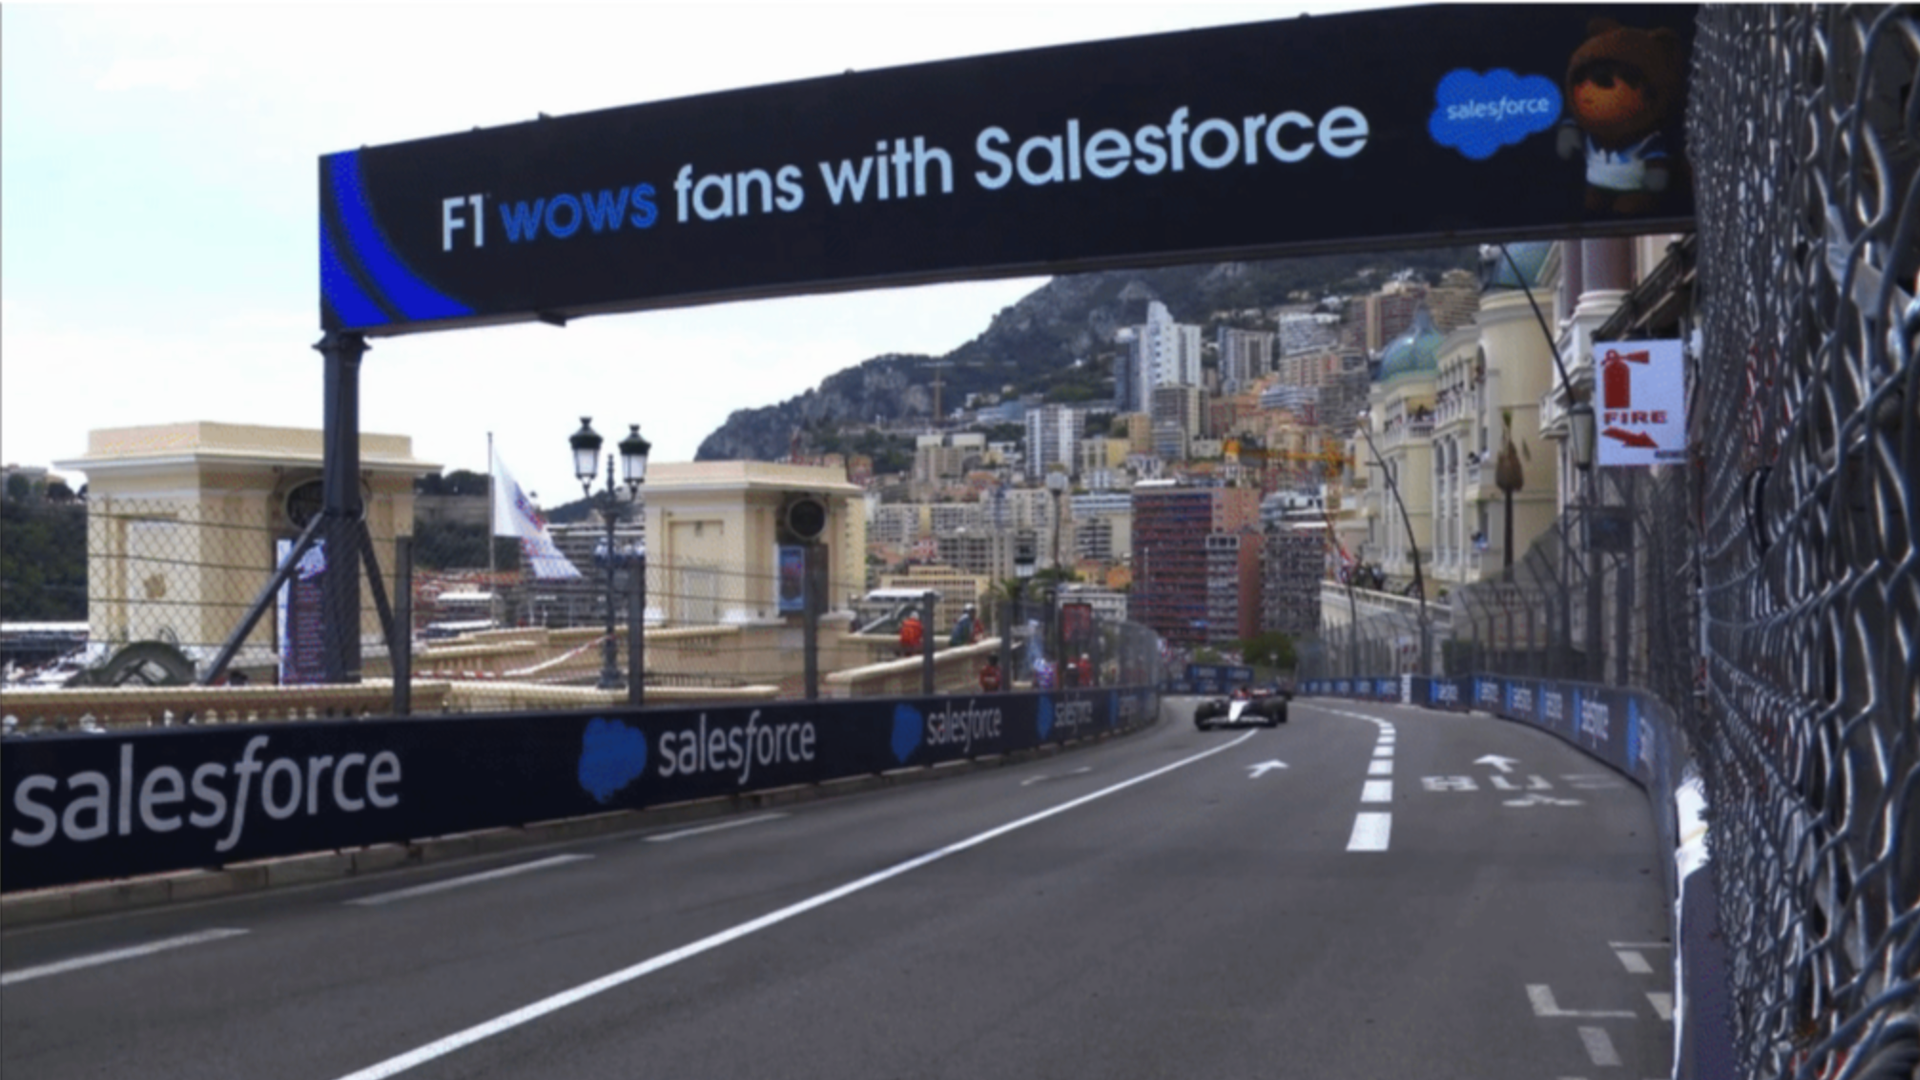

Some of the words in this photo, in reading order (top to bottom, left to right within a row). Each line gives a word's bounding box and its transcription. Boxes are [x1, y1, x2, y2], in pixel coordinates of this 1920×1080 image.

[1446, 95, 1551, 124] salesforce
[442, 193, 484, 252] F1
[499, 182, 659, 243] wows
[674, 164, 804, 223] fans
[819, 135, 953, 205] with
[974, 106, 1369, 190] Salesforce
[1604, 411, 1667, 424] FIRE
[658, 709, 816, 786] salesforce
[926, 699, 1003, 753] salesforce
[11, 735, 403, 853] salesforce
